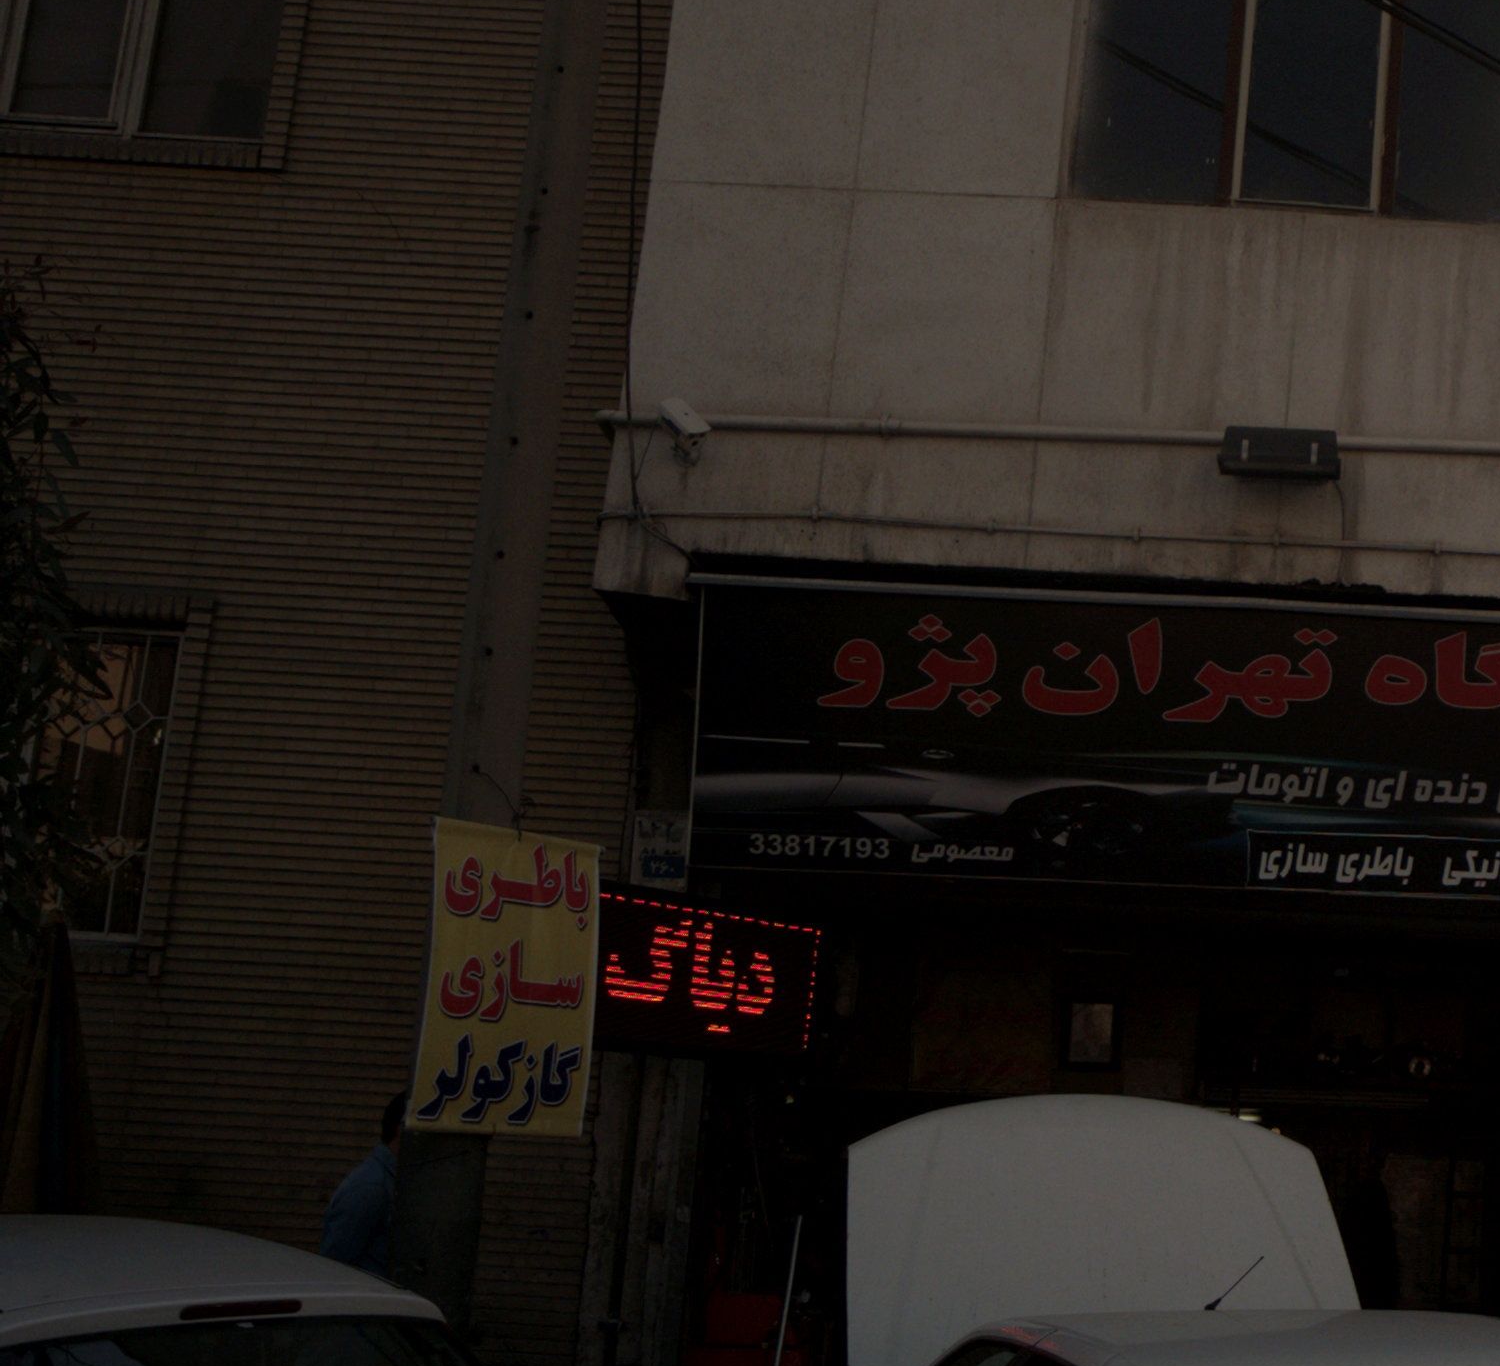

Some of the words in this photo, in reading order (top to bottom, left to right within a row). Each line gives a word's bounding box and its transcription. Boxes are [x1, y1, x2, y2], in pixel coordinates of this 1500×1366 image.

[816, 613, 1002, 718] پژو
[1022, 616, 1338, 723] تهران
[1206, 762, 1330, 804] اتومات
[1334, 775, 1354, 808] و
[1362, 769, 1408, 811] ای
[1412, 772, 1488, 806] دنده
[747, 832, 892, 861] 33817193
[911, 841, 1015, 864] معصومی
[1256, 841, 1330, 882] سازی
[1335, 844, 1415, 888] باطری
[444, 843, 588, 930] باطری
[440, 938, 584, 1021] سازی
[603, 919, 776, 1034] دیاگ
